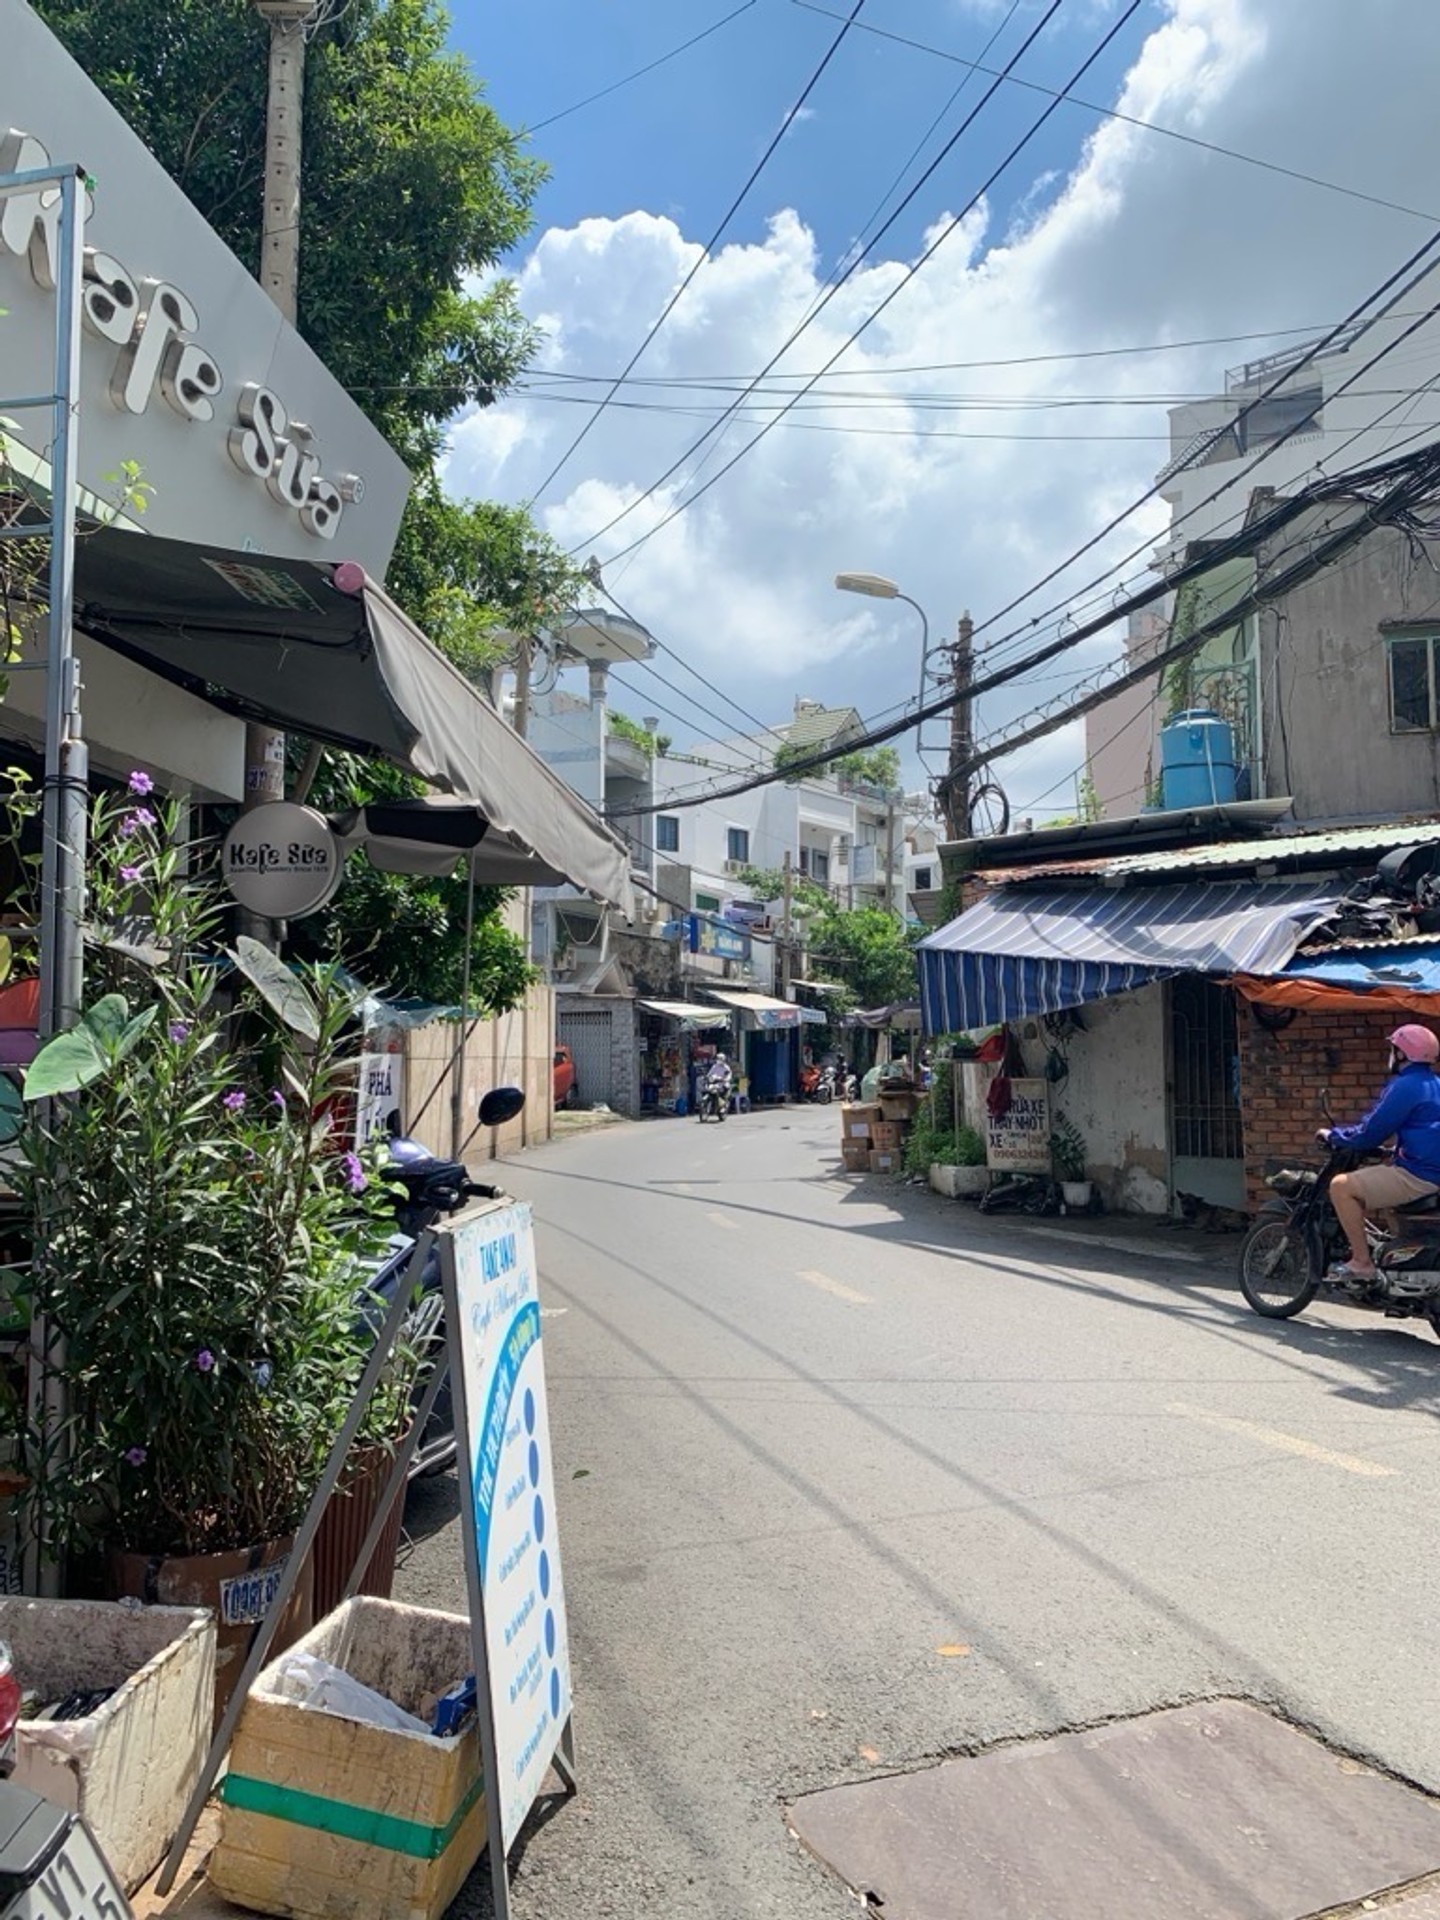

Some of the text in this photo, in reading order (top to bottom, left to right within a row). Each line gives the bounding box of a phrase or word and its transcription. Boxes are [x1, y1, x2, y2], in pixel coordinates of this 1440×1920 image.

[230, 842, 328, 875] Kafe Sữa
[368, 1064, 393, 1096] PHÁ
